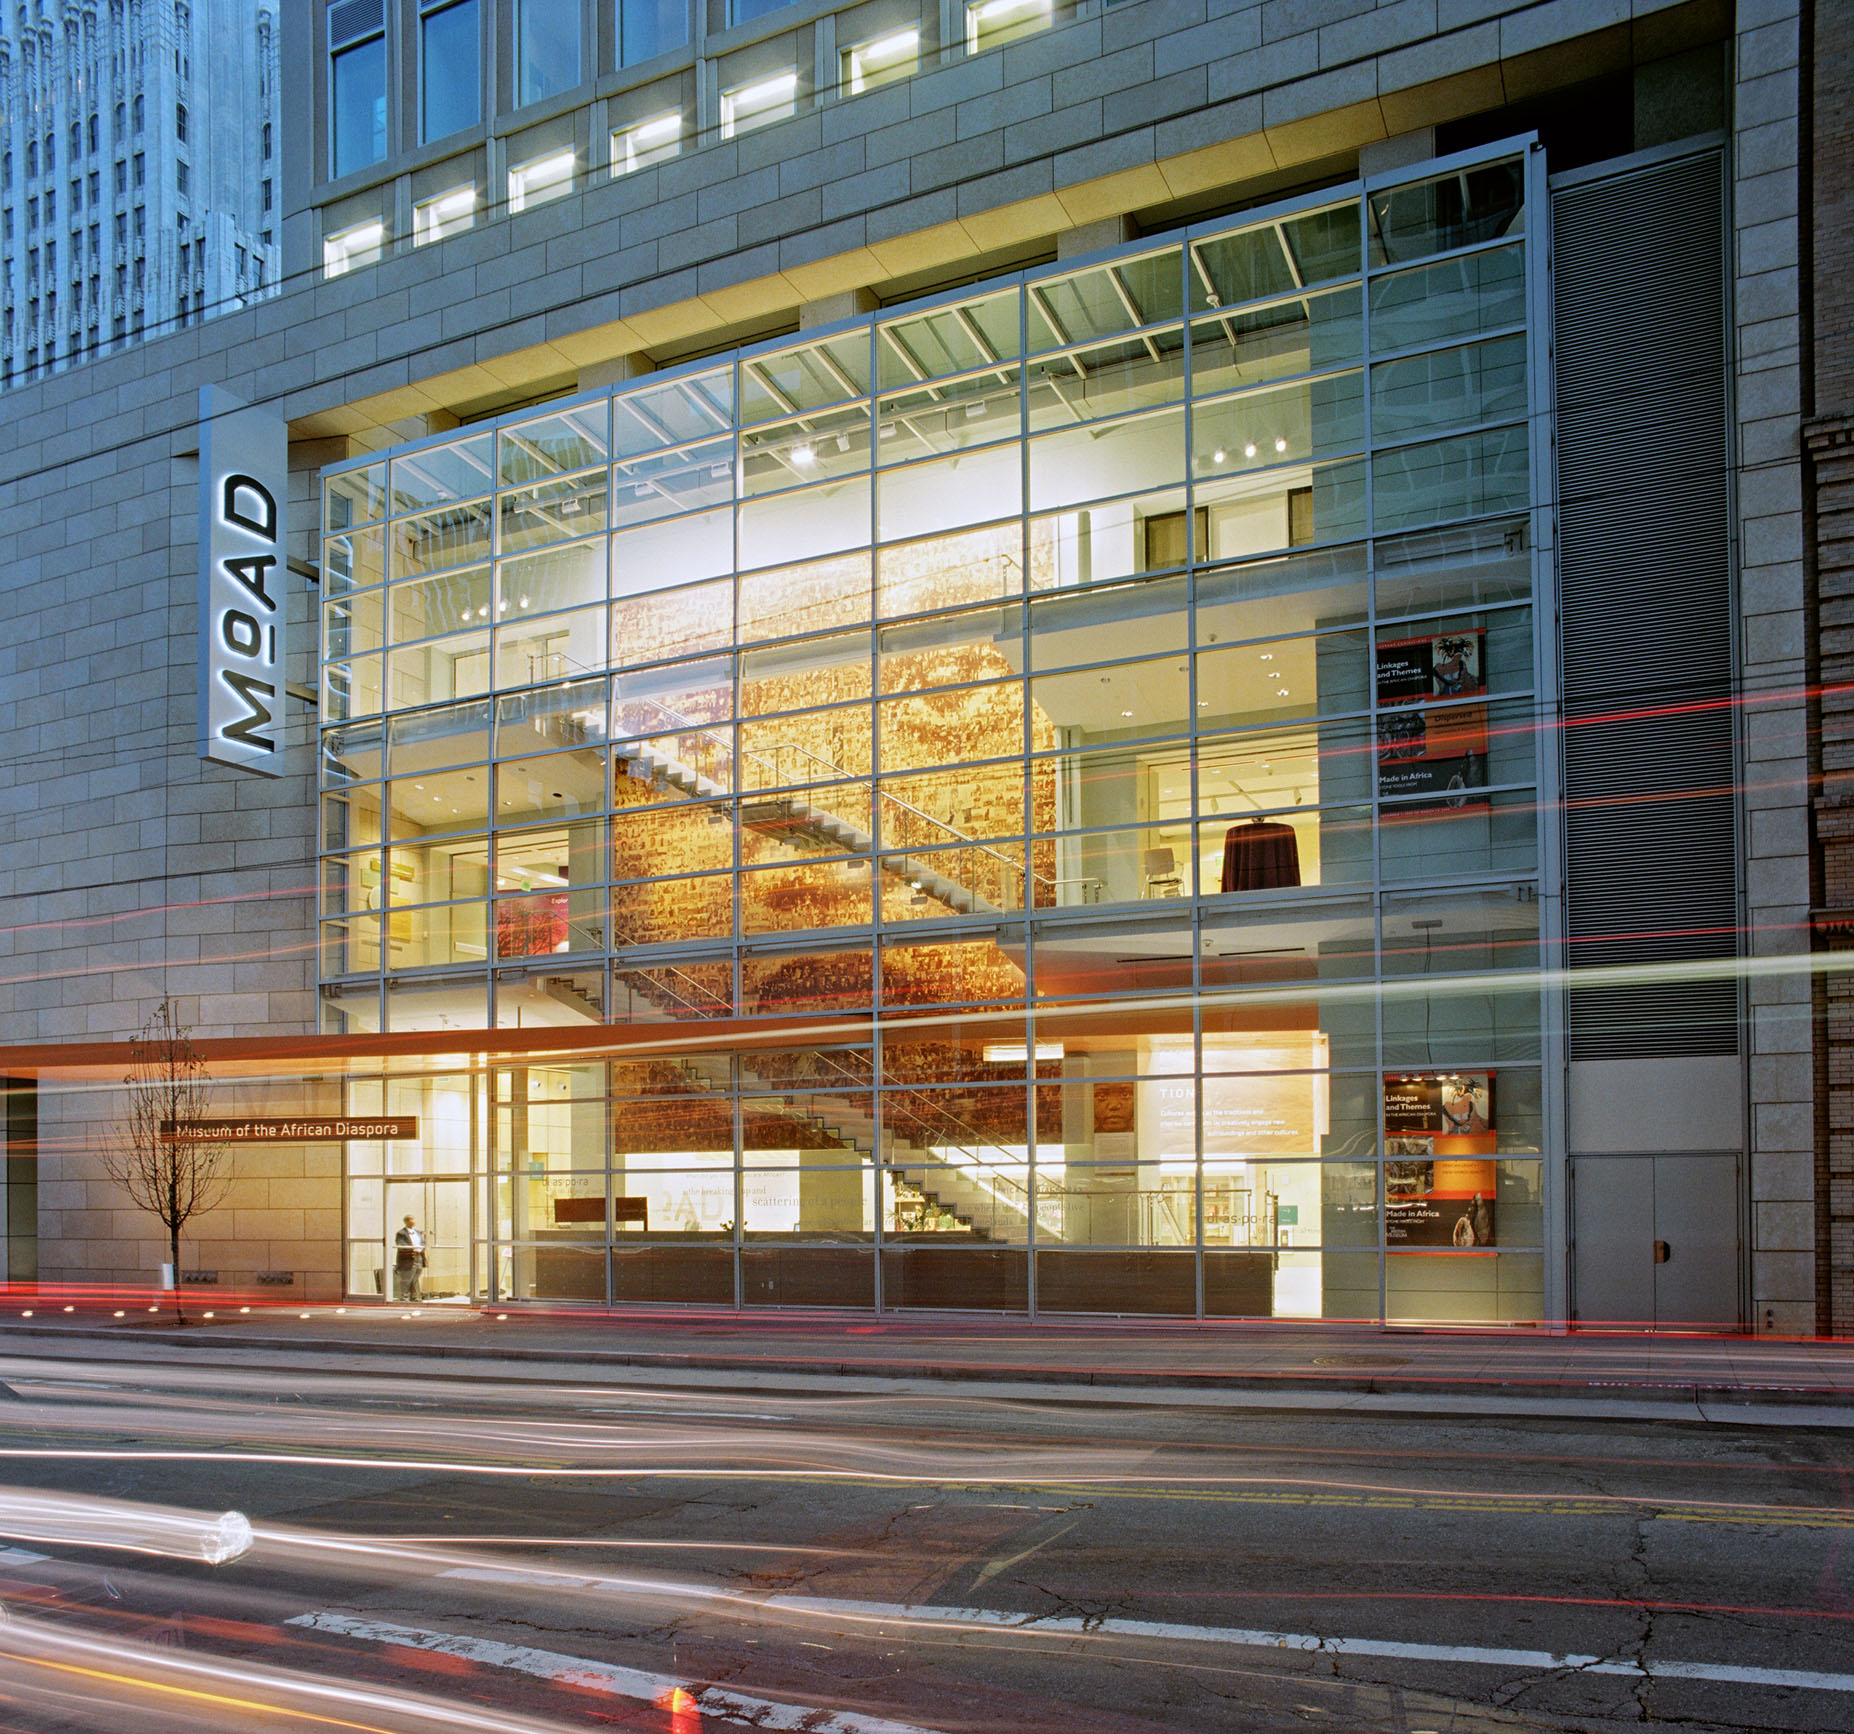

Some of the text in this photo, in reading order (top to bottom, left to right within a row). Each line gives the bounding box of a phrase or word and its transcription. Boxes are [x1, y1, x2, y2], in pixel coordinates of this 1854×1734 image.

[1376, 660, 1409, 671] Linkages
[1376, 667, 1422, 679] and Themes
[1379, 776, 1401, 784] Made
[1409, 772, 1433, 781] Africa
[1386, 1094, 1419, 1103] Linkages
[1400, 1103, 1431, 1111] Themes
[176, 1122, 399, 1138] Museum of the African Diaspora
[1386, 1209, 1440, 1218] Made in Africa
